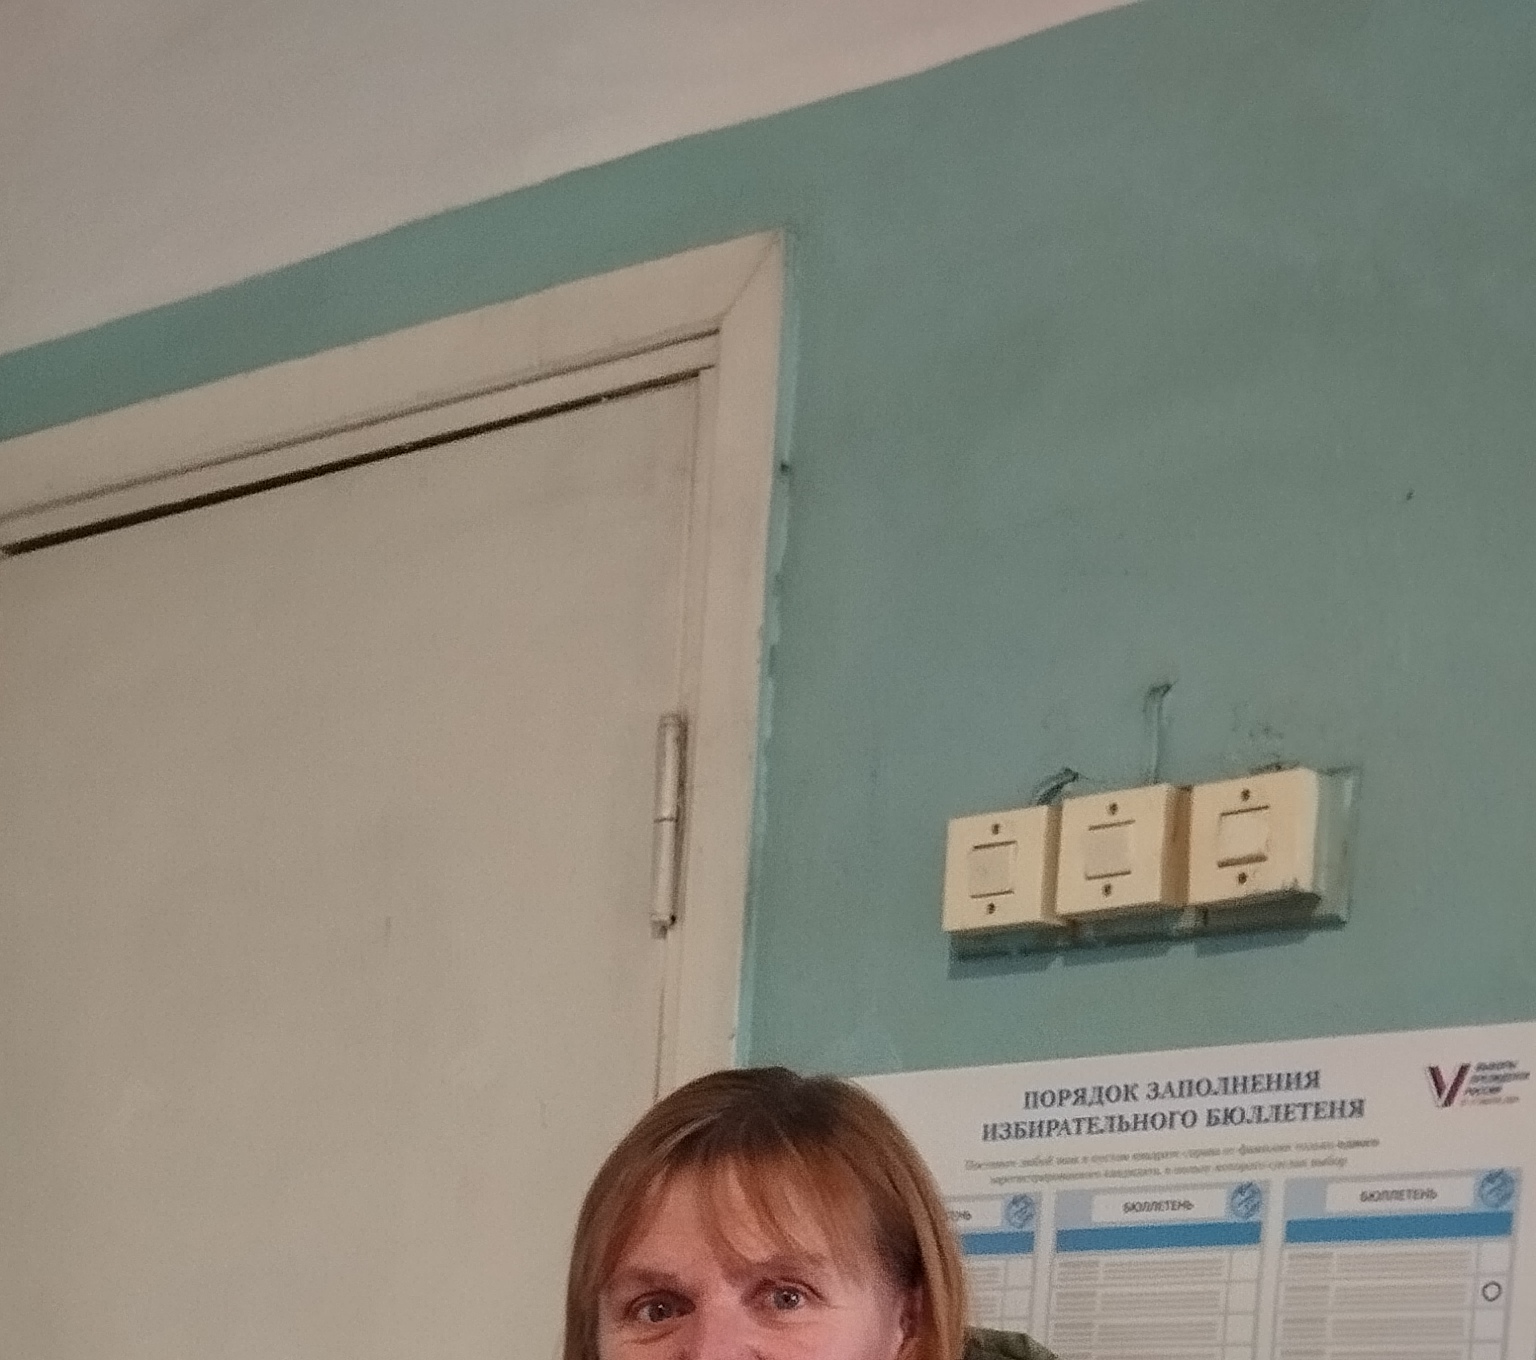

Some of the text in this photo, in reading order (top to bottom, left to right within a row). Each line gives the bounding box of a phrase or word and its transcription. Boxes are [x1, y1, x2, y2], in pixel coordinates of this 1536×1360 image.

[1023, 1069, 1321, 1111] ПОРЯДОК ЗАПОЛНЕНИЯ
[981, 1098, 1366, 1142] ИЗБИРАТЕЛЬНОГО БЮЛЛЕТЕНЯ
[1122, 1199, 1195, 1214] БЮЛЛЕТЕНЬ
[1360, 1187, 1439, 1203] БЮЛЛЕТЕНЬ
